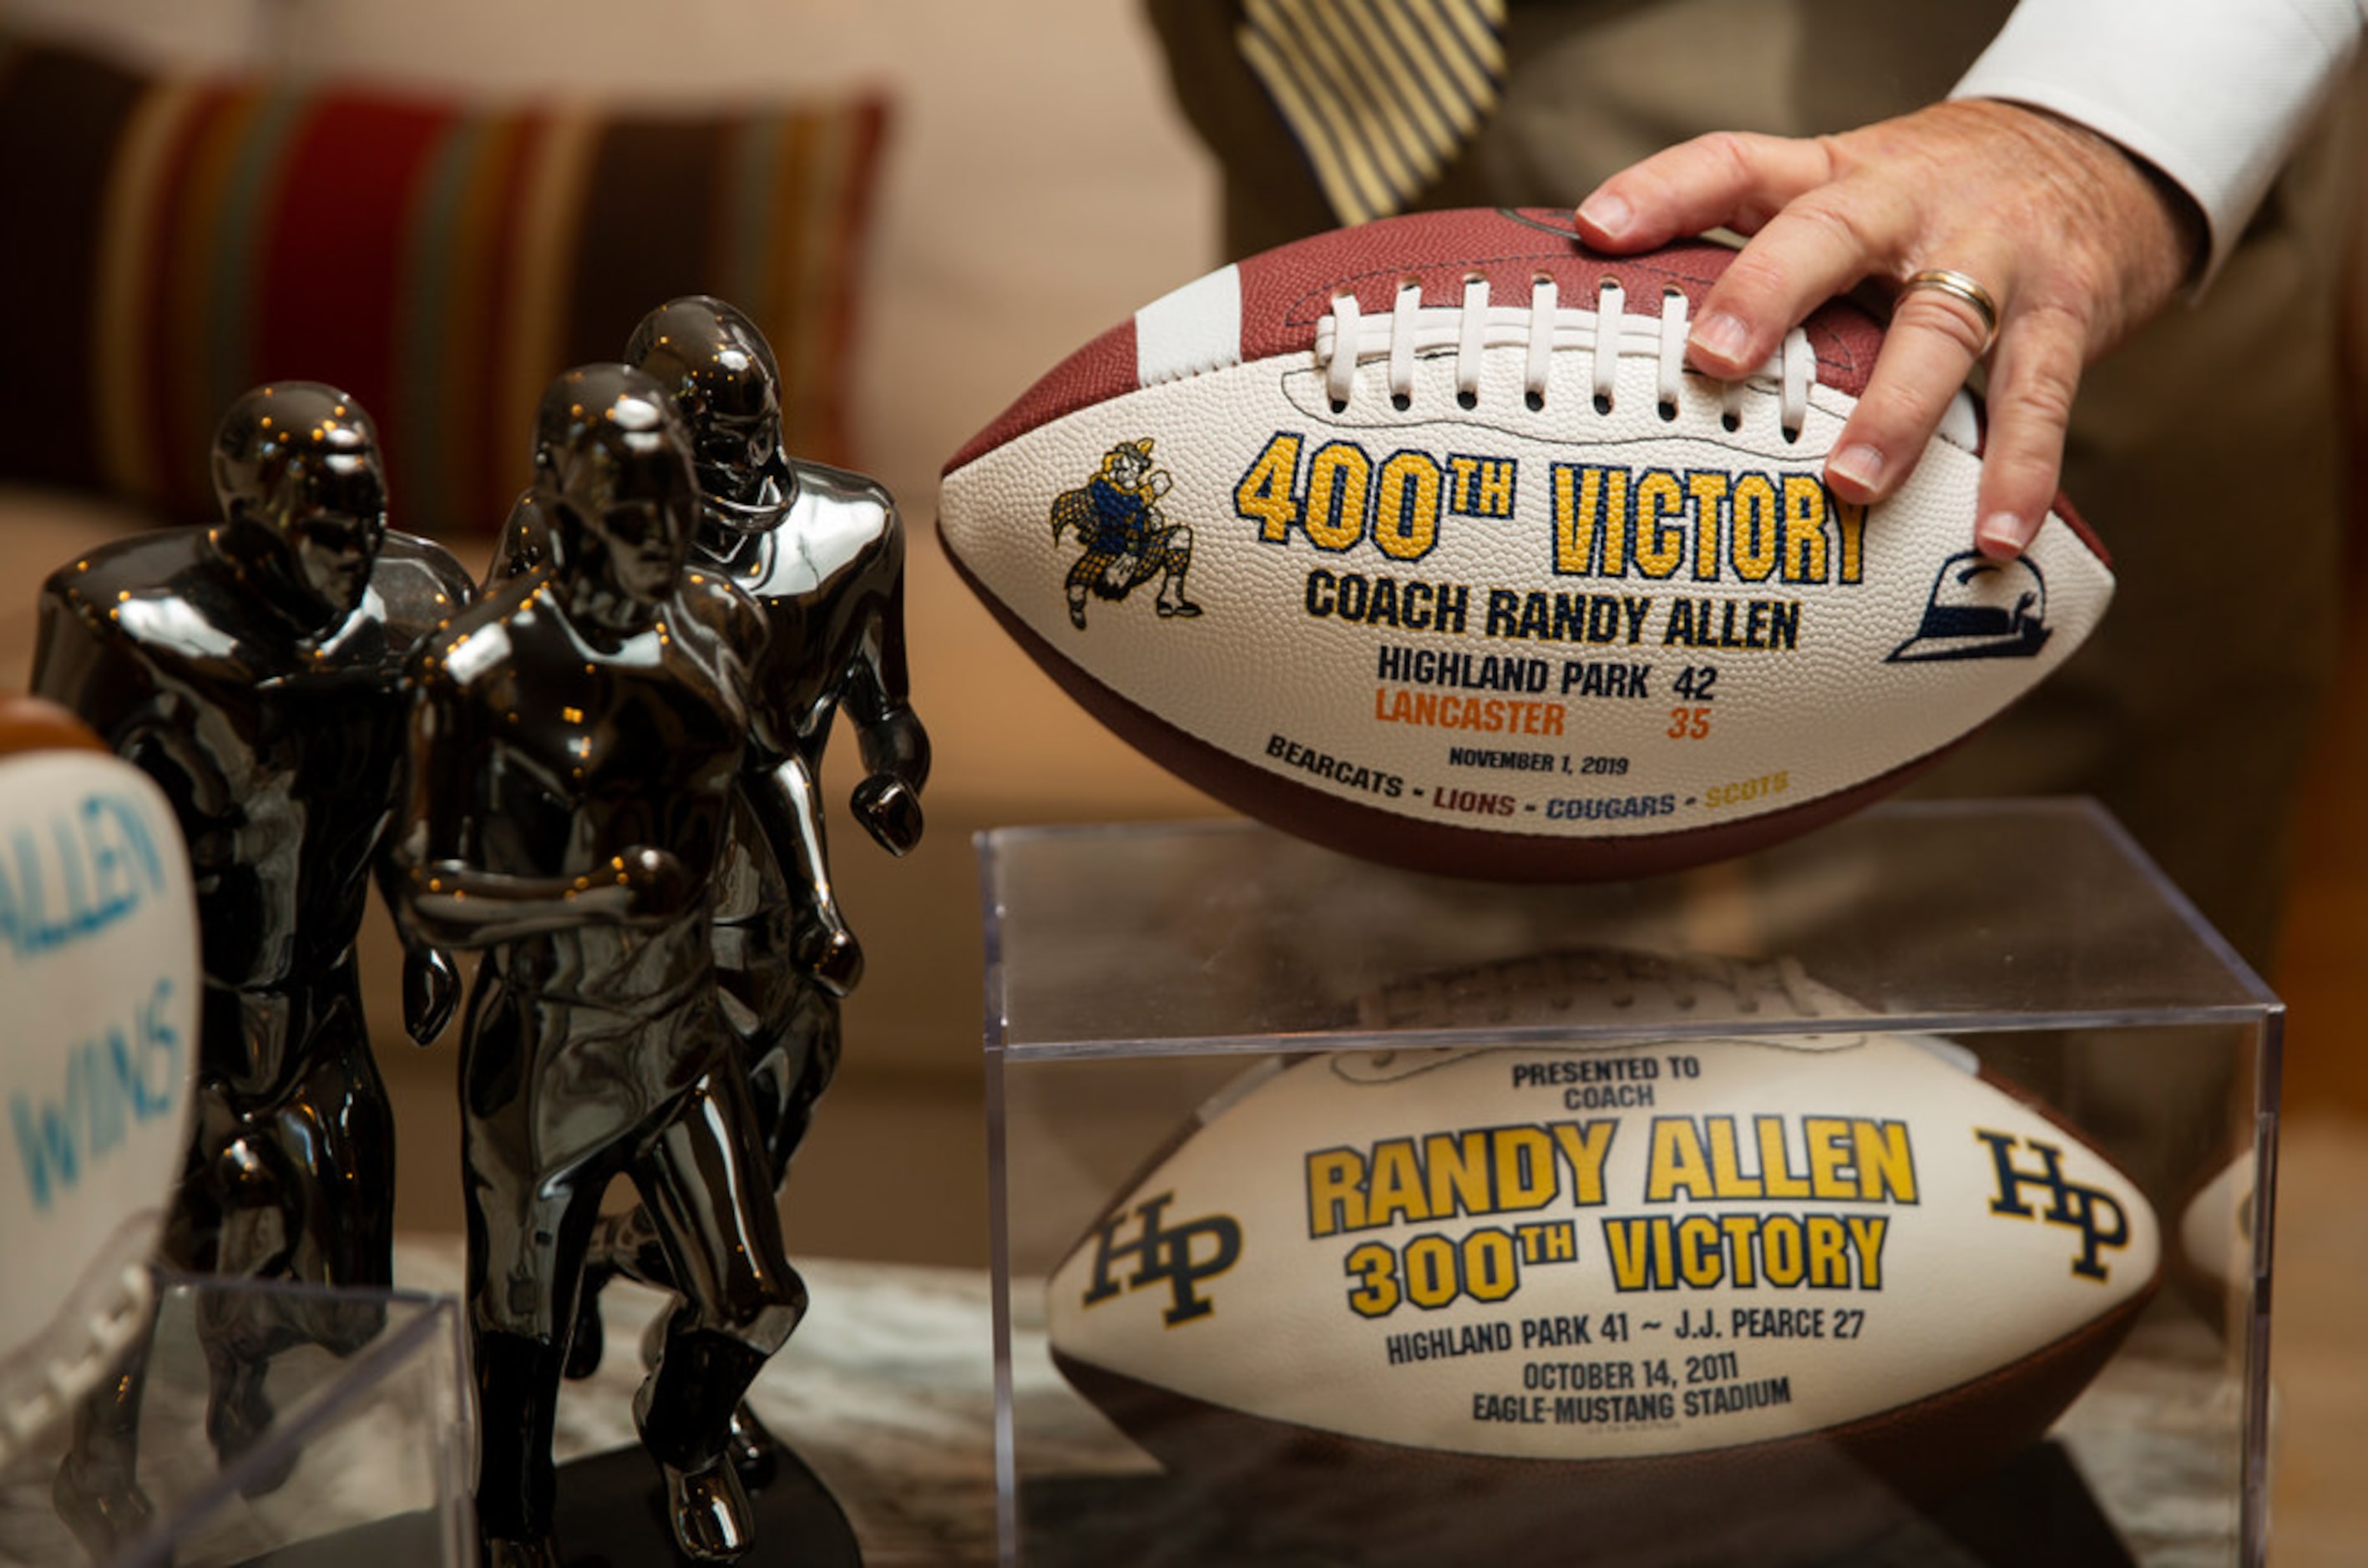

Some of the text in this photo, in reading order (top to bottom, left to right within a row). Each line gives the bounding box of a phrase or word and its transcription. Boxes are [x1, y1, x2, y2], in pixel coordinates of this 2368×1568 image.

[1233, 431, 1868, 584] 400TH VICTORY
[1305, 569, 1801, 650] COACH RANDY ALLEN
[1378, 645, 1718, 701] HIGHLAND PARK 42
[1375, 689, 1711, 740] LANCASTER 35
[1265, 734, 1404, 799] BEARCATS
[1433, 787, 1515, 817] LIONS
[1546, 796, 1675, 821] COUGARS
[1705, 771, 1789, 808] SCOTS
[1450, 746, 1629, 776] NOVEMBER 1, 2019
[8, 975, 183, 1215] WINS
[1512, 1056, 1700, 1086] PRESENTED TO
[1564, 1085, 1654, 1110] COACH
[1303, 1115, 1920, 1240] RANDY ALLEN
[1974, 1127, 2130, 1285] HP
[1081, 1190, 1243, 1330] HP
[1344, 1213, 1890, 1318] 300TH VICTORY
[1387, 1322, 1512, 1365] HIGHLAND
[1521, 1315, 1591, 1349] PARK
[1601, 1313, 1628, 1343] 41
[1675, 1311, 1722, 1340] J.J.
[1732, 1308, 1826, 1339] PEARCE
[1834, 1309, 1865, 1339] 27
[1523, 1352, 1738, 1390] OCTOBER 14, 2011
[1473, 1377, 1791, 1424] EAGLE-MUSTANG STADIUM
